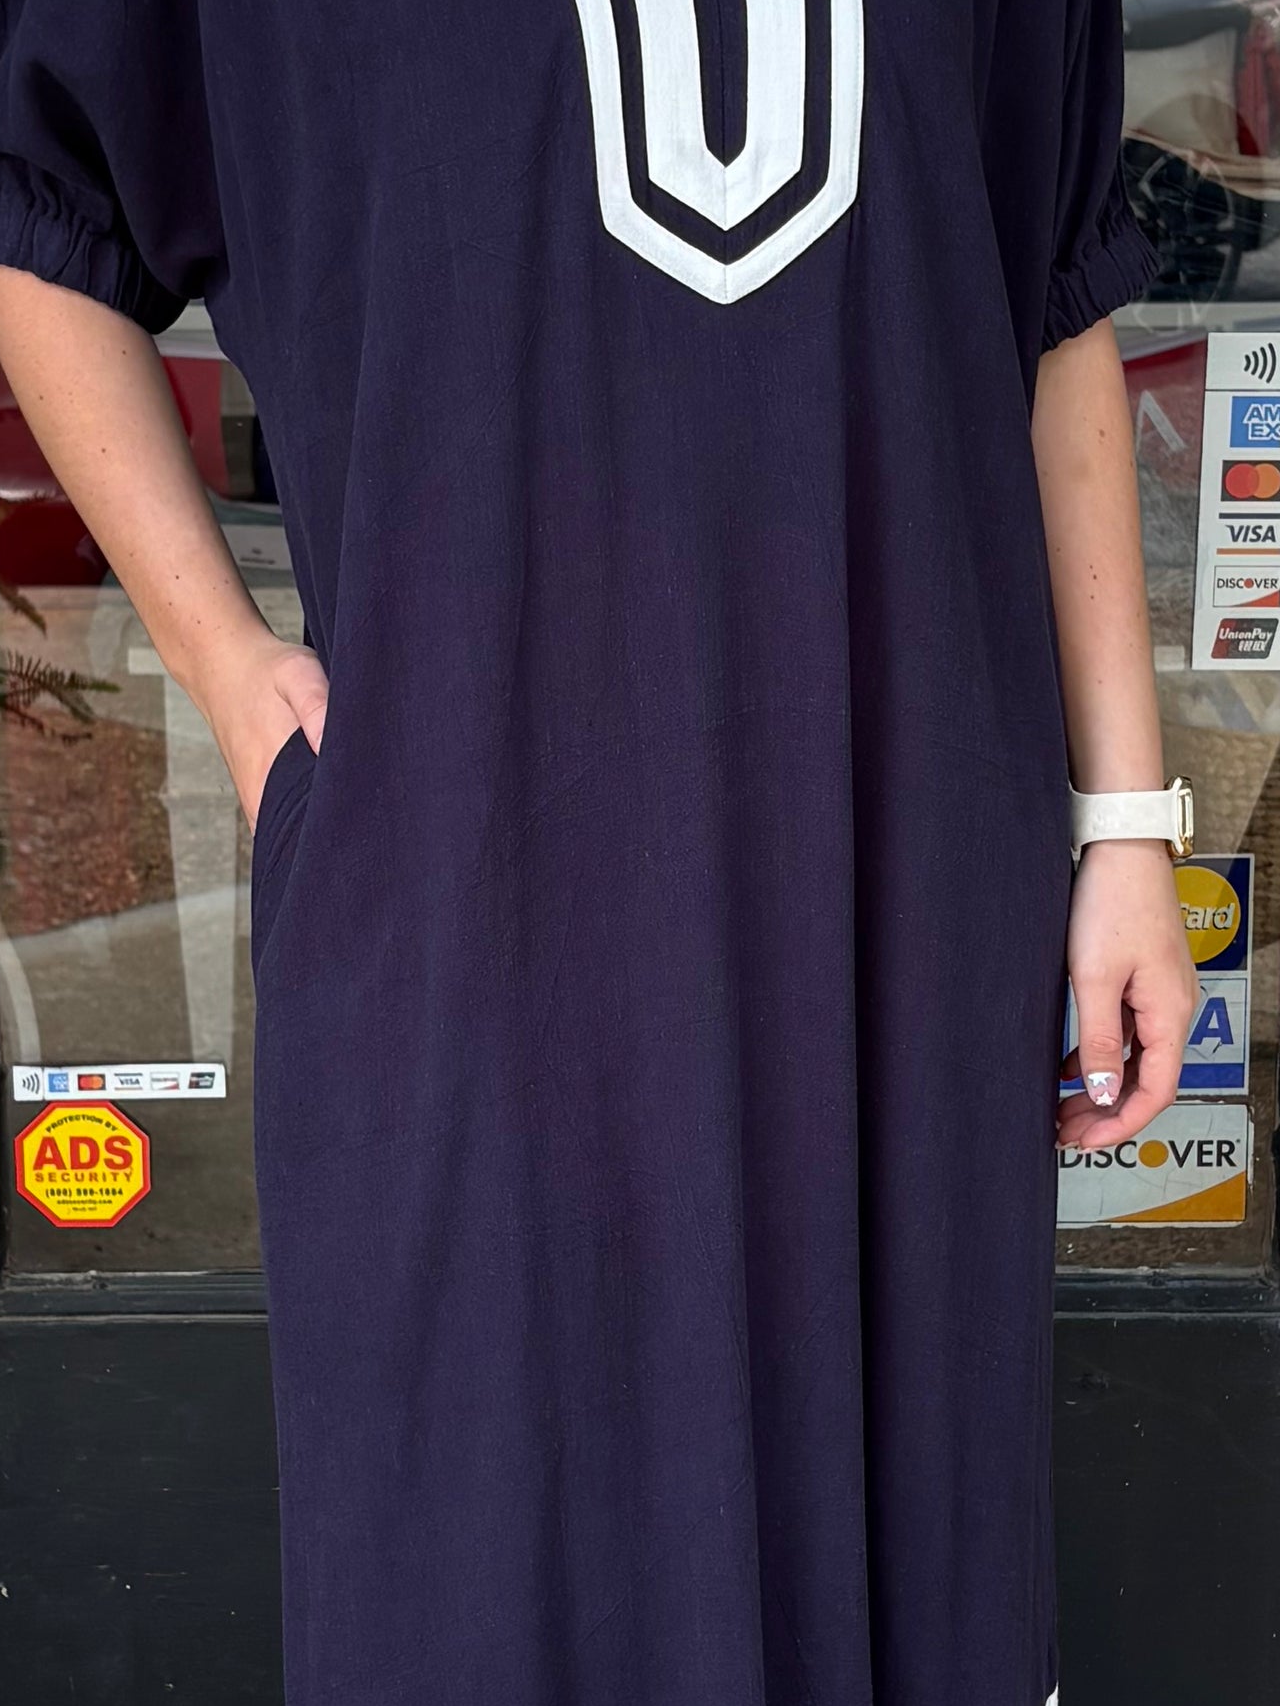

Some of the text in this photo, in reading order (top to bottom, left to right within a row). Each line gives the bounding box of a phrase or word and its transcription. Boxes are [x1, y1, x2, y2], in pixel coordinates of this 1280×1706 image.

[1225, 524, 1276, 543] VISA
[1217, 577, 1278, 589] DISCOVER
[1219, 628, 1272, 644] UnionPay
[119, 1077, 140, 1086] VISA
[45, 1114, 118, 1133] PROTECTION BY
[33, 1135, 133, 1171] ADS
[1059, 1140, 1237, 1169] DISCOVER
[34, 1172, 133, 1183] SECURITY
